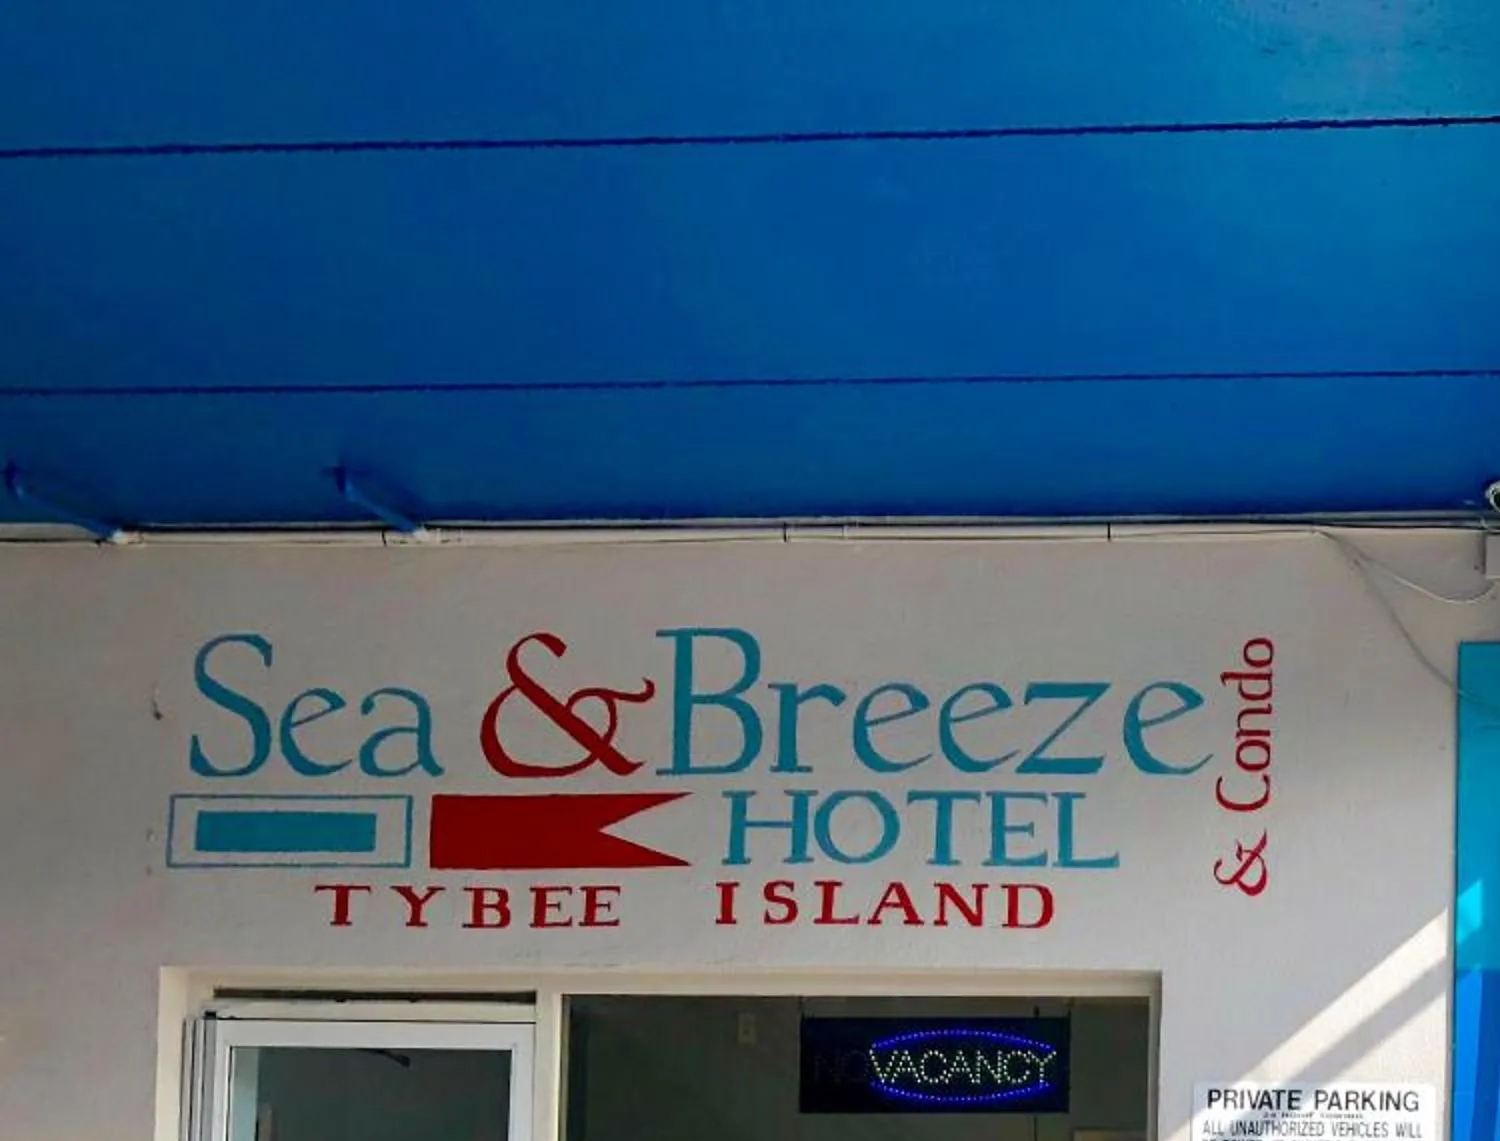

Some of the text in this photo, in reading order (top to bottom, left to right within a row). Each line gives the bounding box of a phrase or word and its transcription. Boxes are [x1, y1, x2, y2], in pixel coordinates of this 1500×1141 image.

[190, 627, 1214, 779] Sea & Breeze
[1215, 636, 1275, 897] & Condo
[722, 789, 1121, 870] HOTEL
[315, 880, 1058, 930] TYBEE ISLAND
[868, 1049, 1058, 1084] VACANCY
[1207, 1089, 1420, 1112] PRIVATE PARKING
[1203, 1120, 1423, 1139] ALL UNAUTHORIZED VEHICLES WILL
